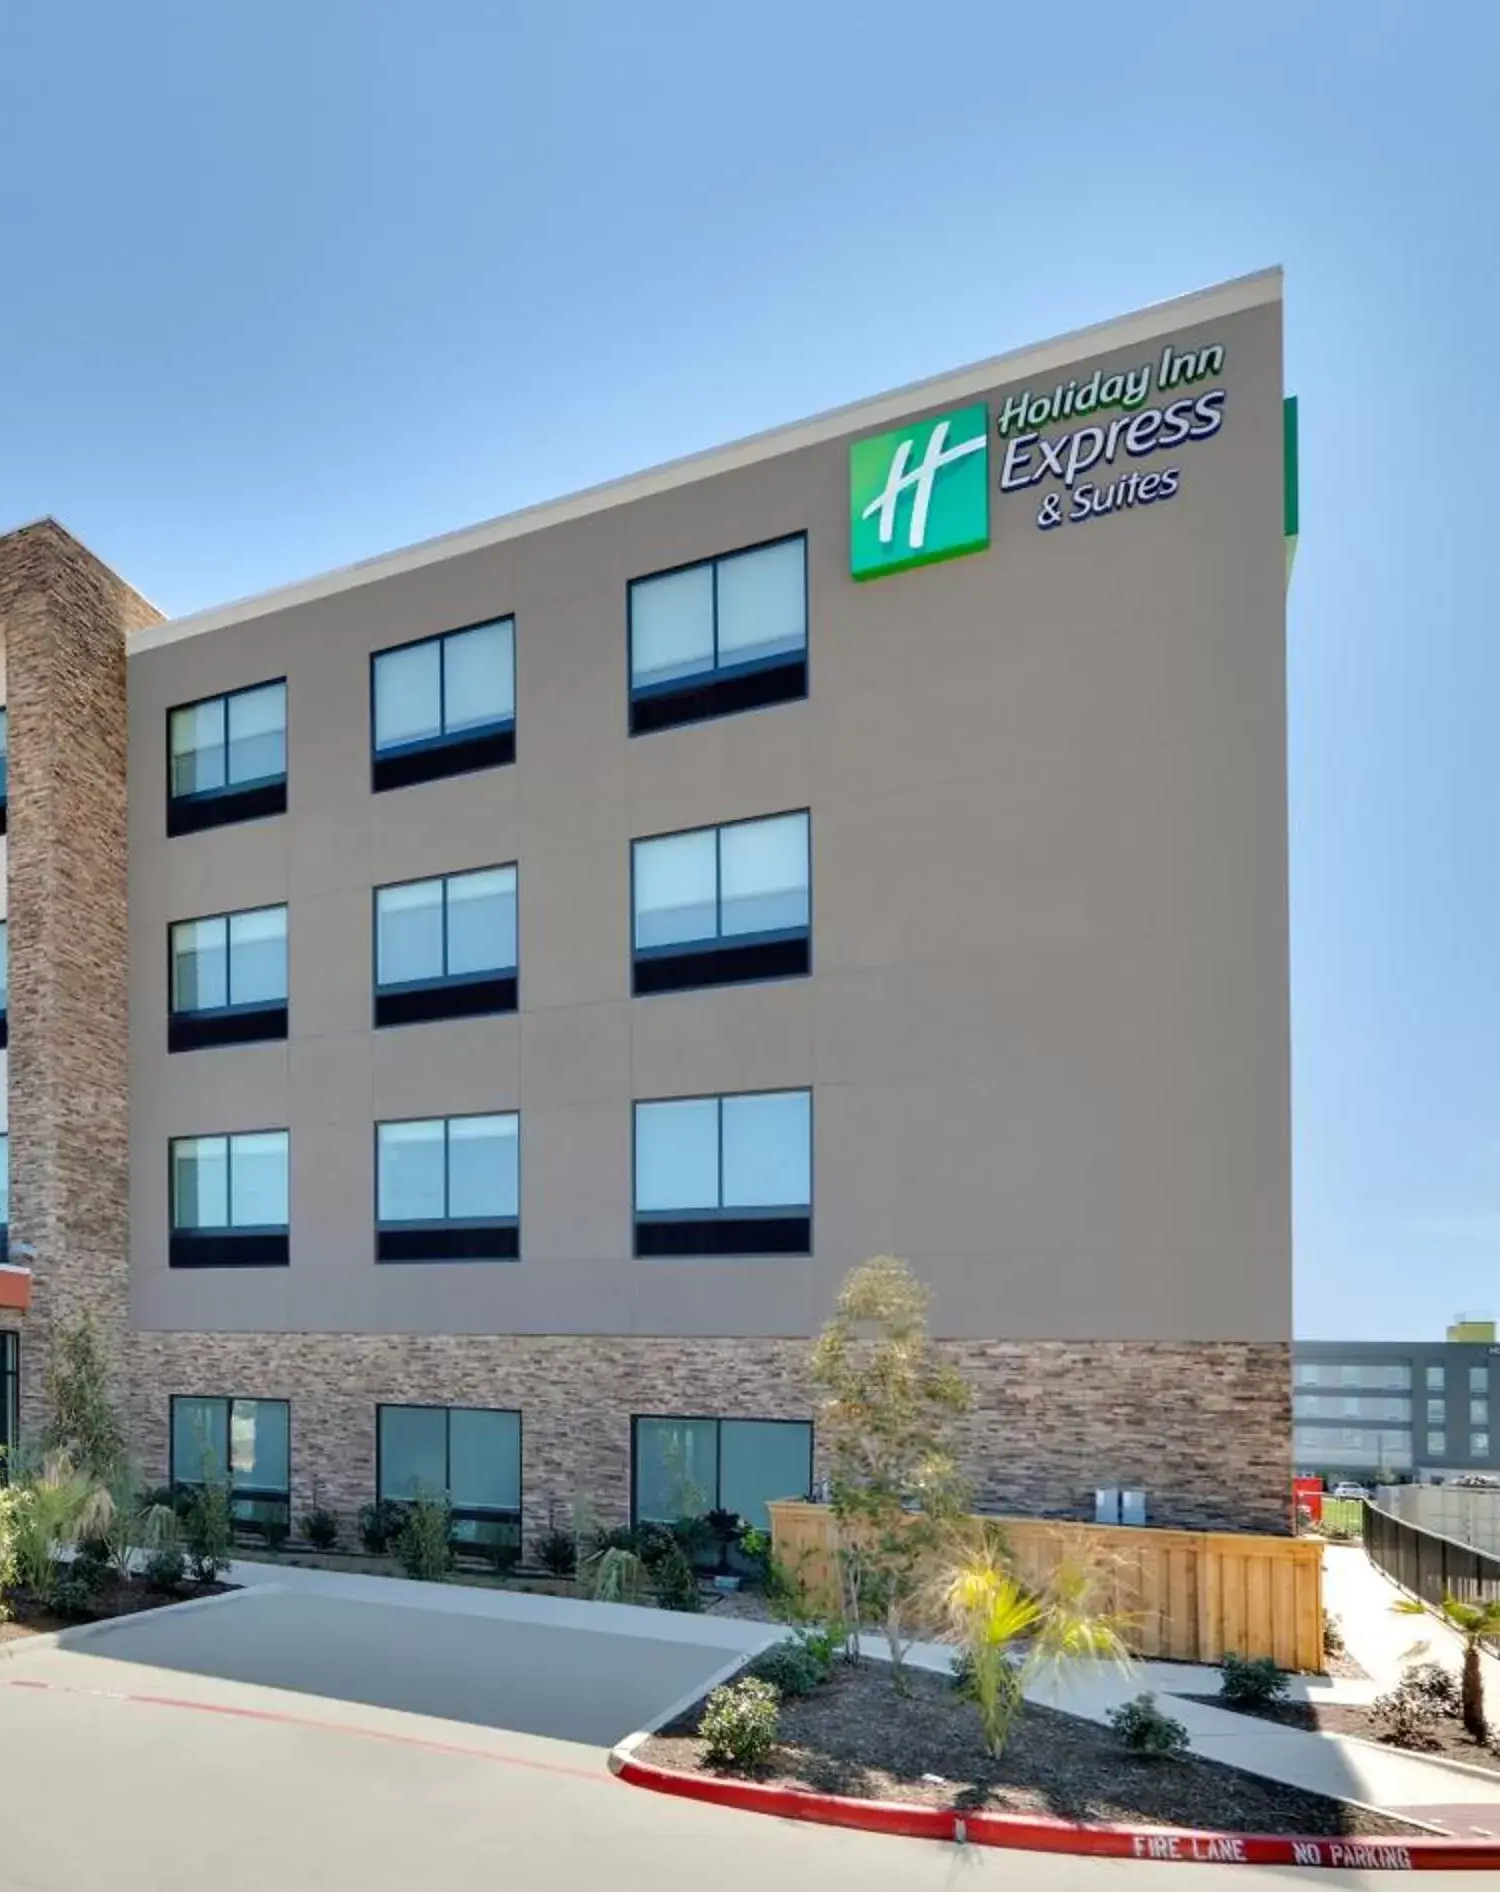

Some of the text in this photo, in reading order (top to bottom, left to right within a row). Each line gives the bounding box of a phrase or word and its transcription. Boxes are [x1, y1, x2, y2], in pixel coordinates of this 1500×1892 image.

[999, 346, 1223, 433] Holiday Inn
[1001, 391, 1224, 490] Express
[1037, 468, 1180, 527] & Suites
[1132, 1837, 1412, 1869] FIRE LANE NO PARKING
